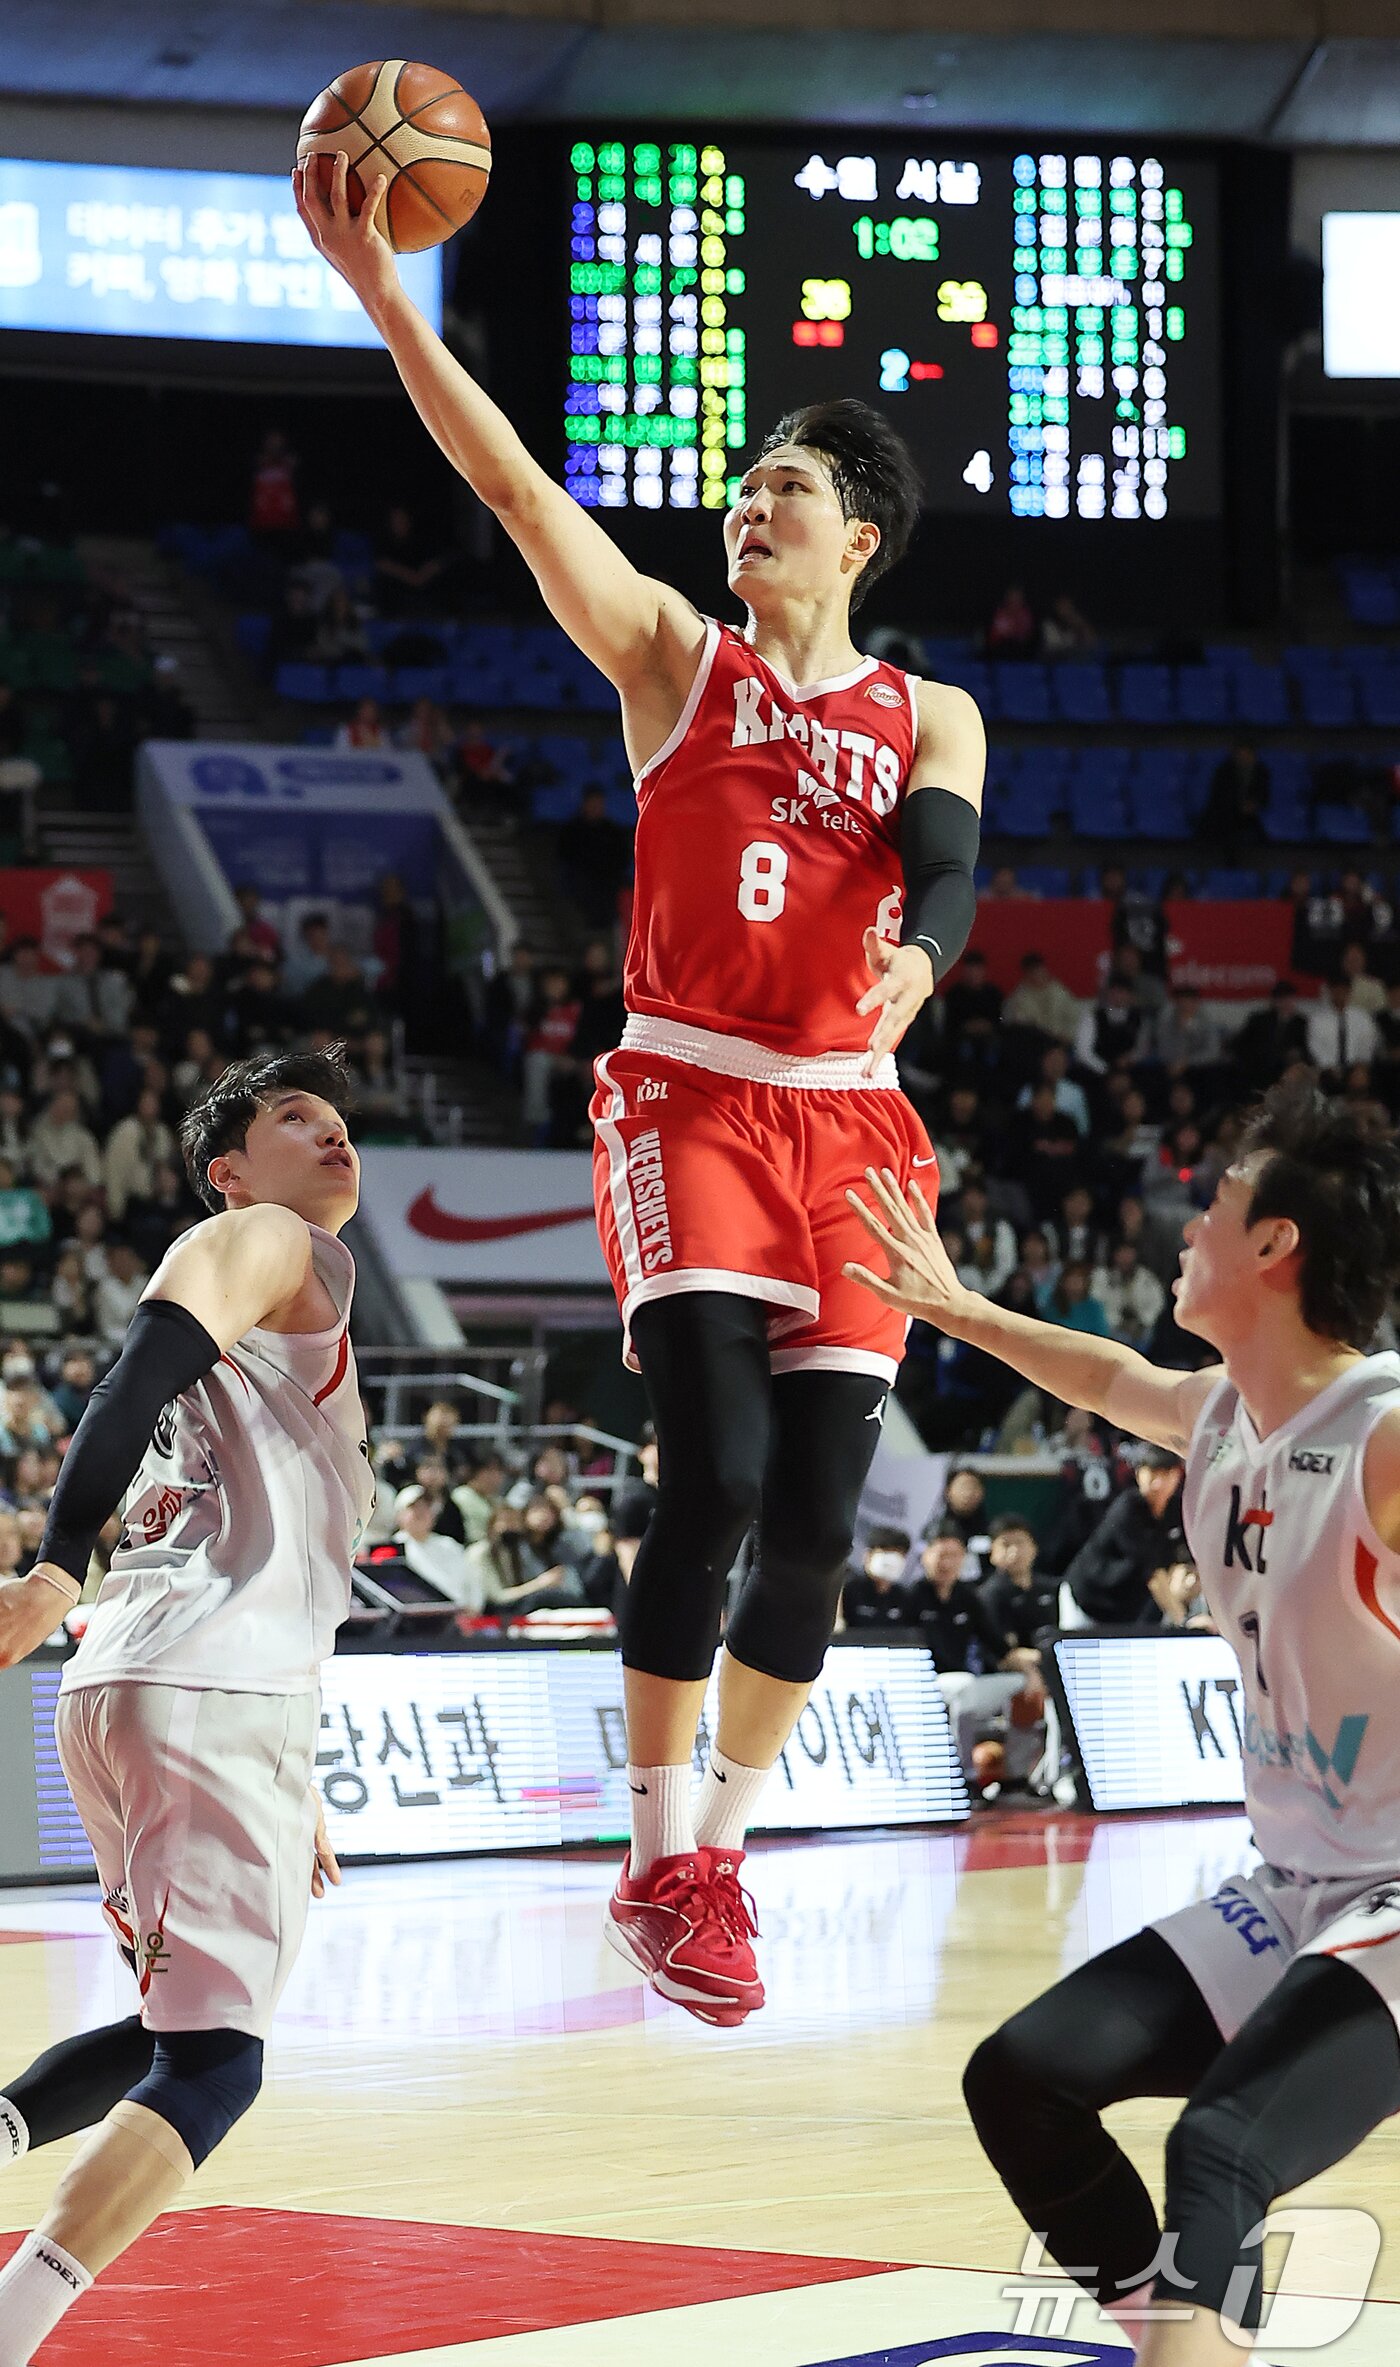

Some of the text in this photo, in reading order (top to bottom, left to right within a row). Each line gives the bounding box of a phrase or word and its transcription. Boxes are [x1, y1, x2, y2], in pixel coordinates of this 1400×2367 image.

[853, 215, 940, 261] 1:02
[769, 796, 809, 826] SK
[737, 840, 789, 923] 8
[636, 1077, 669, 1103] KBL
[629, 1127, 674, 1271] HERSHEY'S
[1223, 1484, 1274, 1575] kt
[35, 2249, 81, 2290] HDEX
